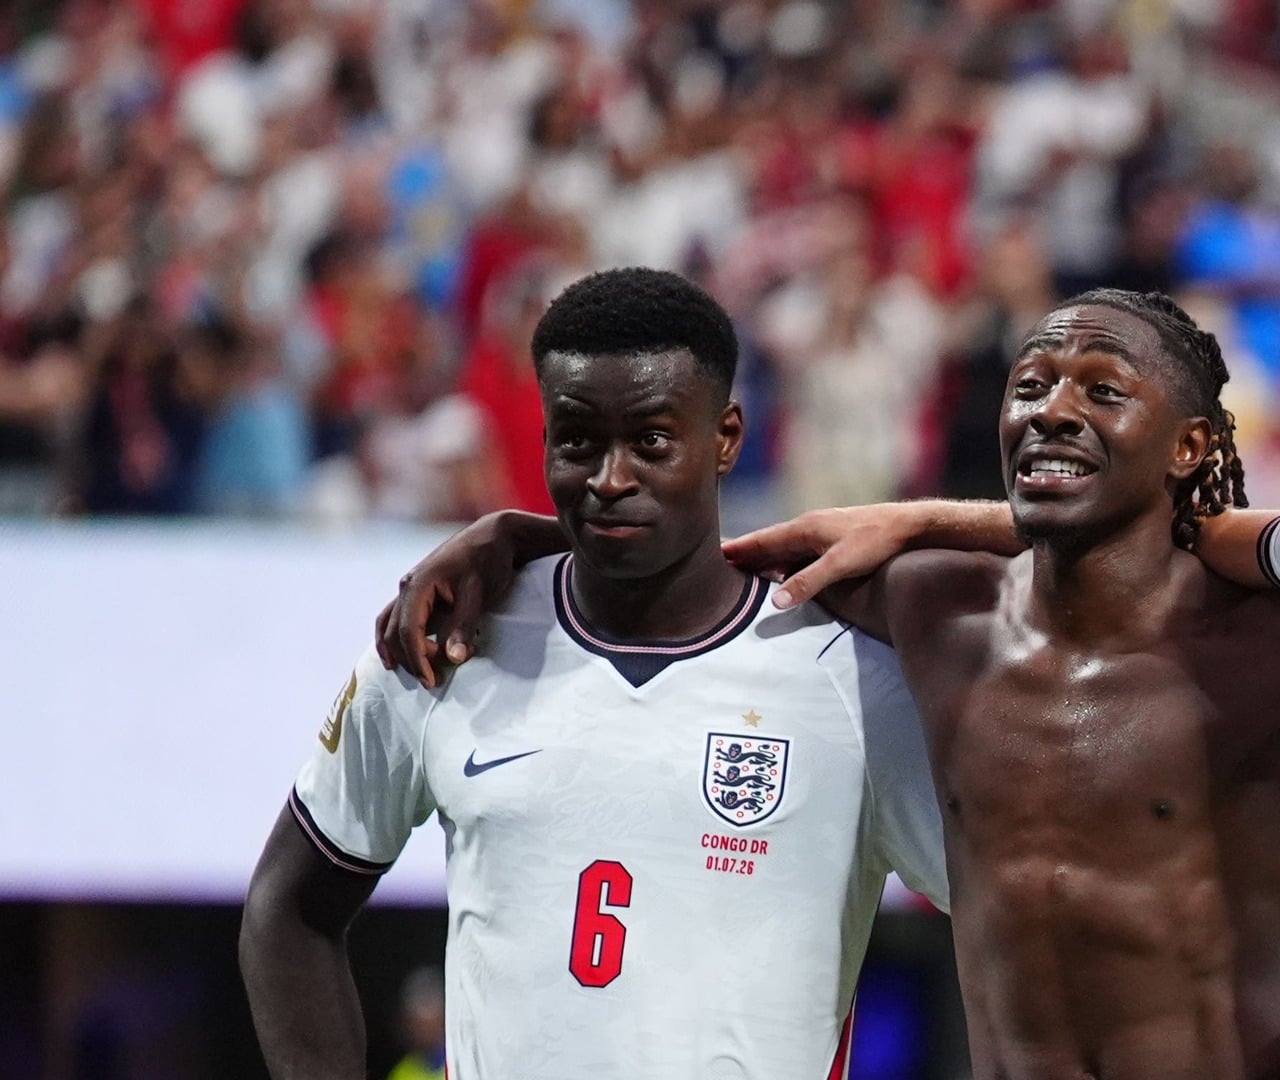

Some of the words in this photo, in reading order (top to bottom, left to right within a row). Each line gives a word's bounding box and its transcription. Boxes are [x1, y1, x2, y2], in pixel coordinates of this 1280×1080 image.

[701, 833, 747, 852] CONGO
[750, 839, 768, 855] DR
[706, 855, 754, 875] 01.07.26
[569, 859, 633, 989] 6
